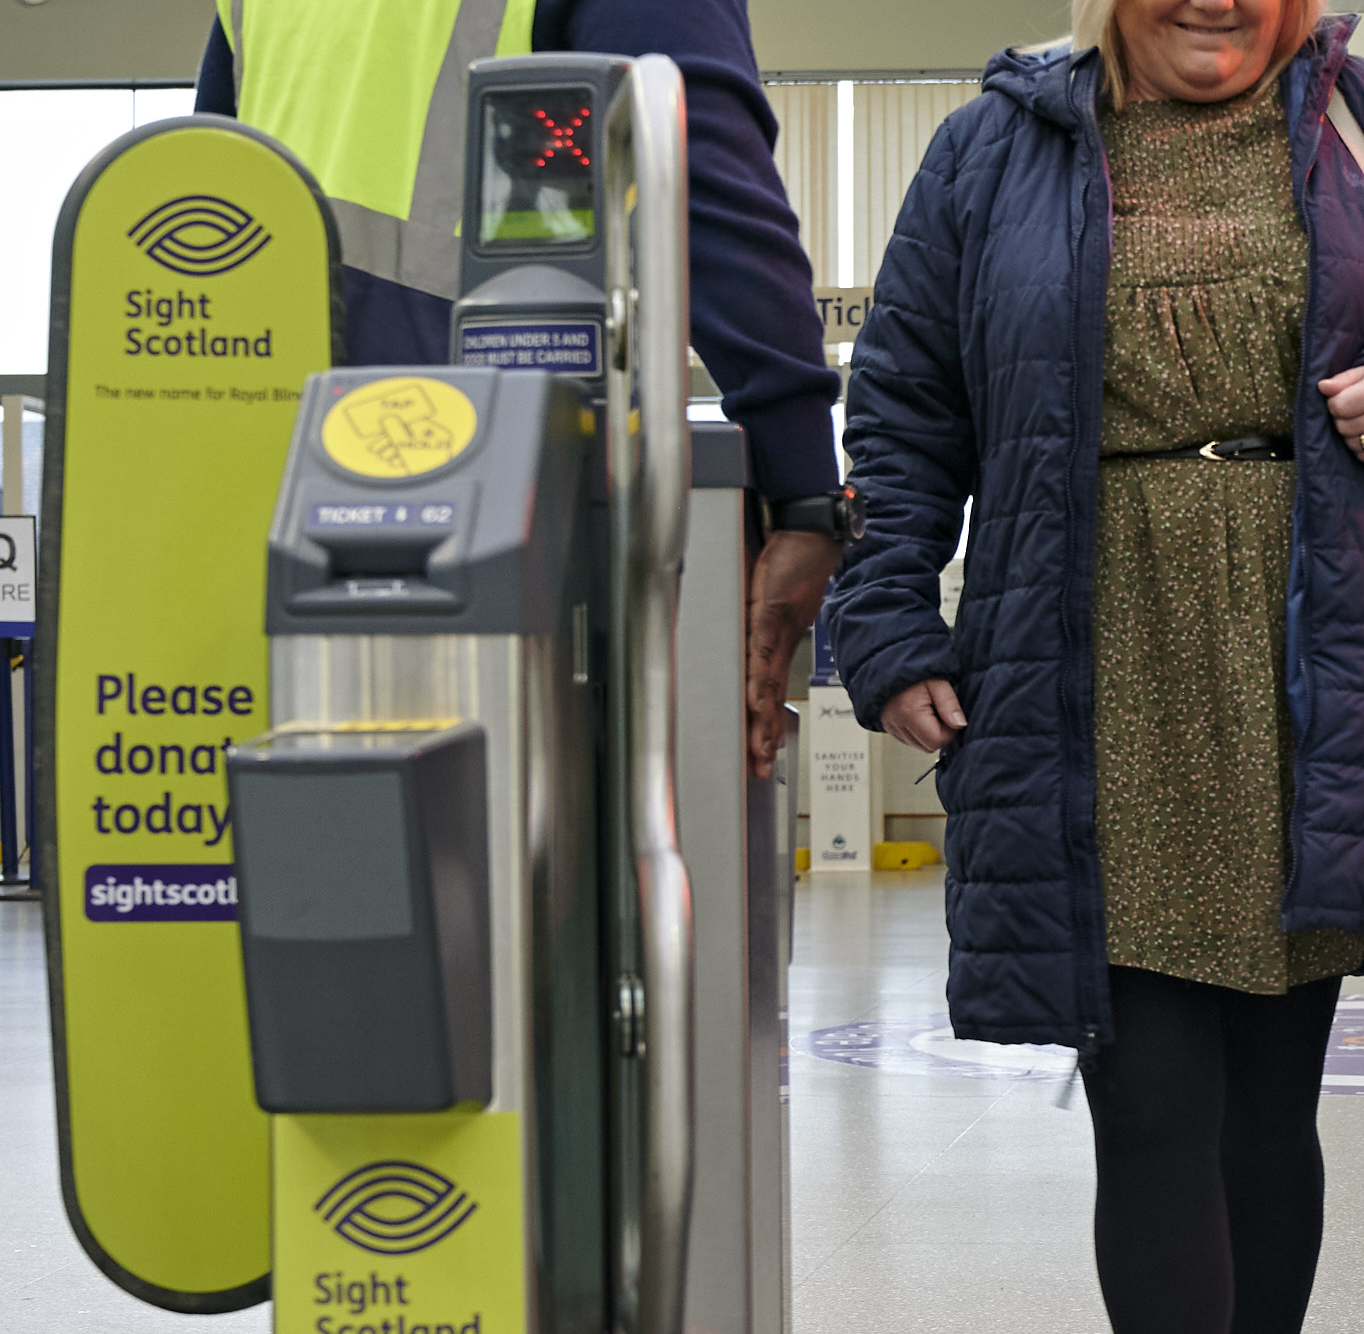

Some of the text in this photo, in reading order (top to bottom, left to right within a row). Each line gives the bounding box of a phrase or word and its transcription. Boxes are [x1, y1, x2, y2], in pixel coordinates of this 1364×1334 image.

[125, 289, 211, 327] Sight
[125, 328, 272, 357] Scotland
[508, 333, 550, 348] UNDER
[561, 332, 589, 347] AND
[487, 351, 515, 365] MUST
[517, 350, 534, 364] BE
[536, 349, 592, 364] CARRIED
[95, 384, 303, 404] The new name for Royal Blin
[318, 505, 387, 525] TICKET
[97, 672, 254, 715] Please
[815, 752, 865, 761] SANITISE
[91, 792, 230, 846] today
[91, 876, 238, 913] sightscotl
[313, 1271, 410, 1314] Sight
